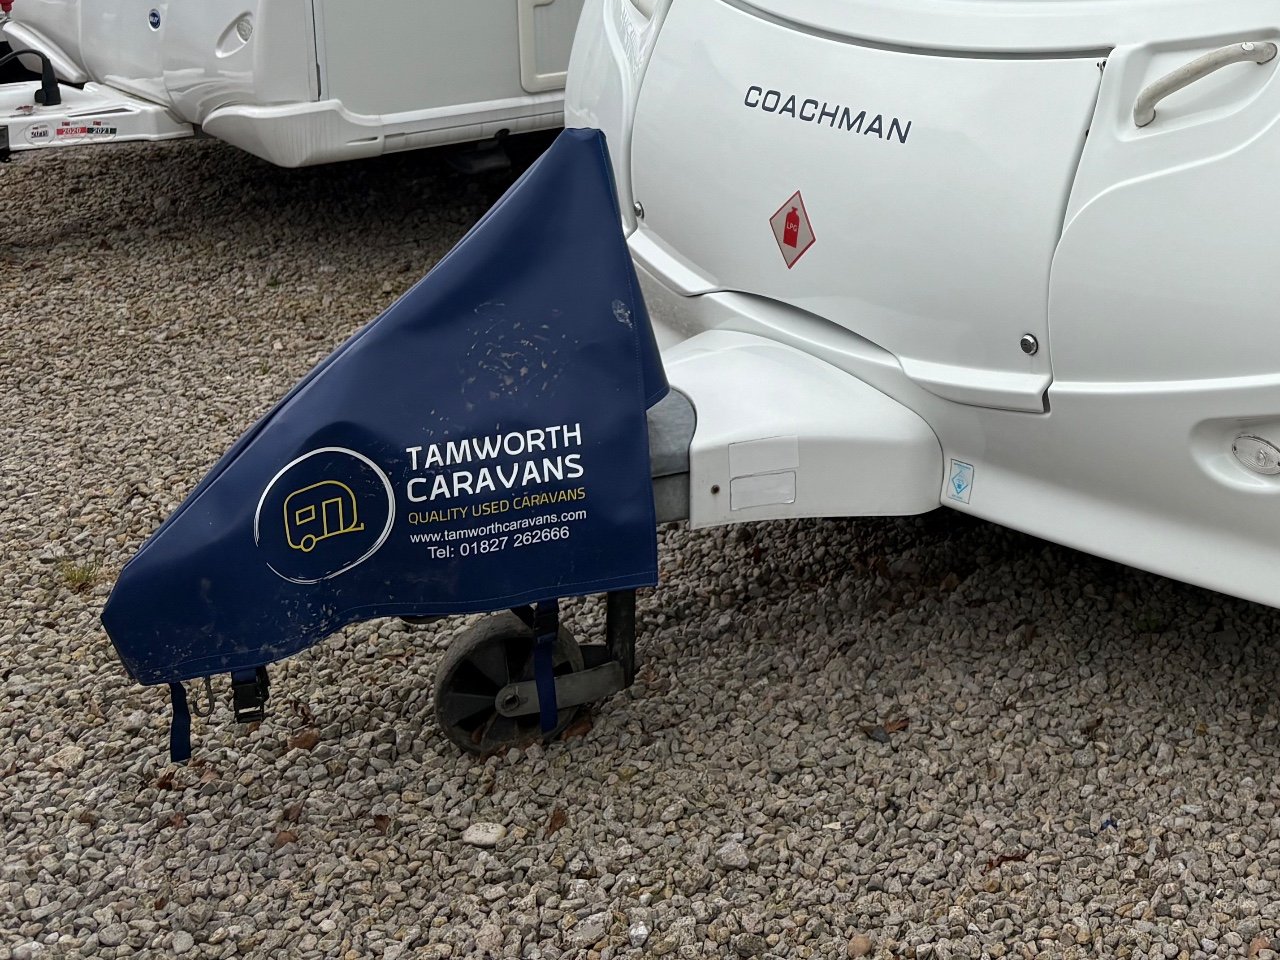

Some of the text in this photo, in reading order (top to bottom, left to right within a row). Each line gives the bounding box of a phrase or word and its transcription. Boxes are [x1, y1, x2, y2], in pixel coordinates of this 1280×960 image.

[62, 127, 81, 135] 2020
[744, 85, 912, 144] COACHMAN
[786, 222, 799, 232] LPG
[405, 422, 583, 471] TAMWORTH
[406, 453, 585, 503] CARAVANS
[408, 486, 587, 526] QUALITY USED CARAVANS
[409, 507, 588, 545] www.tamworthcaravans.com
[427, 525, 571, 560] Tel: 01827 262666
